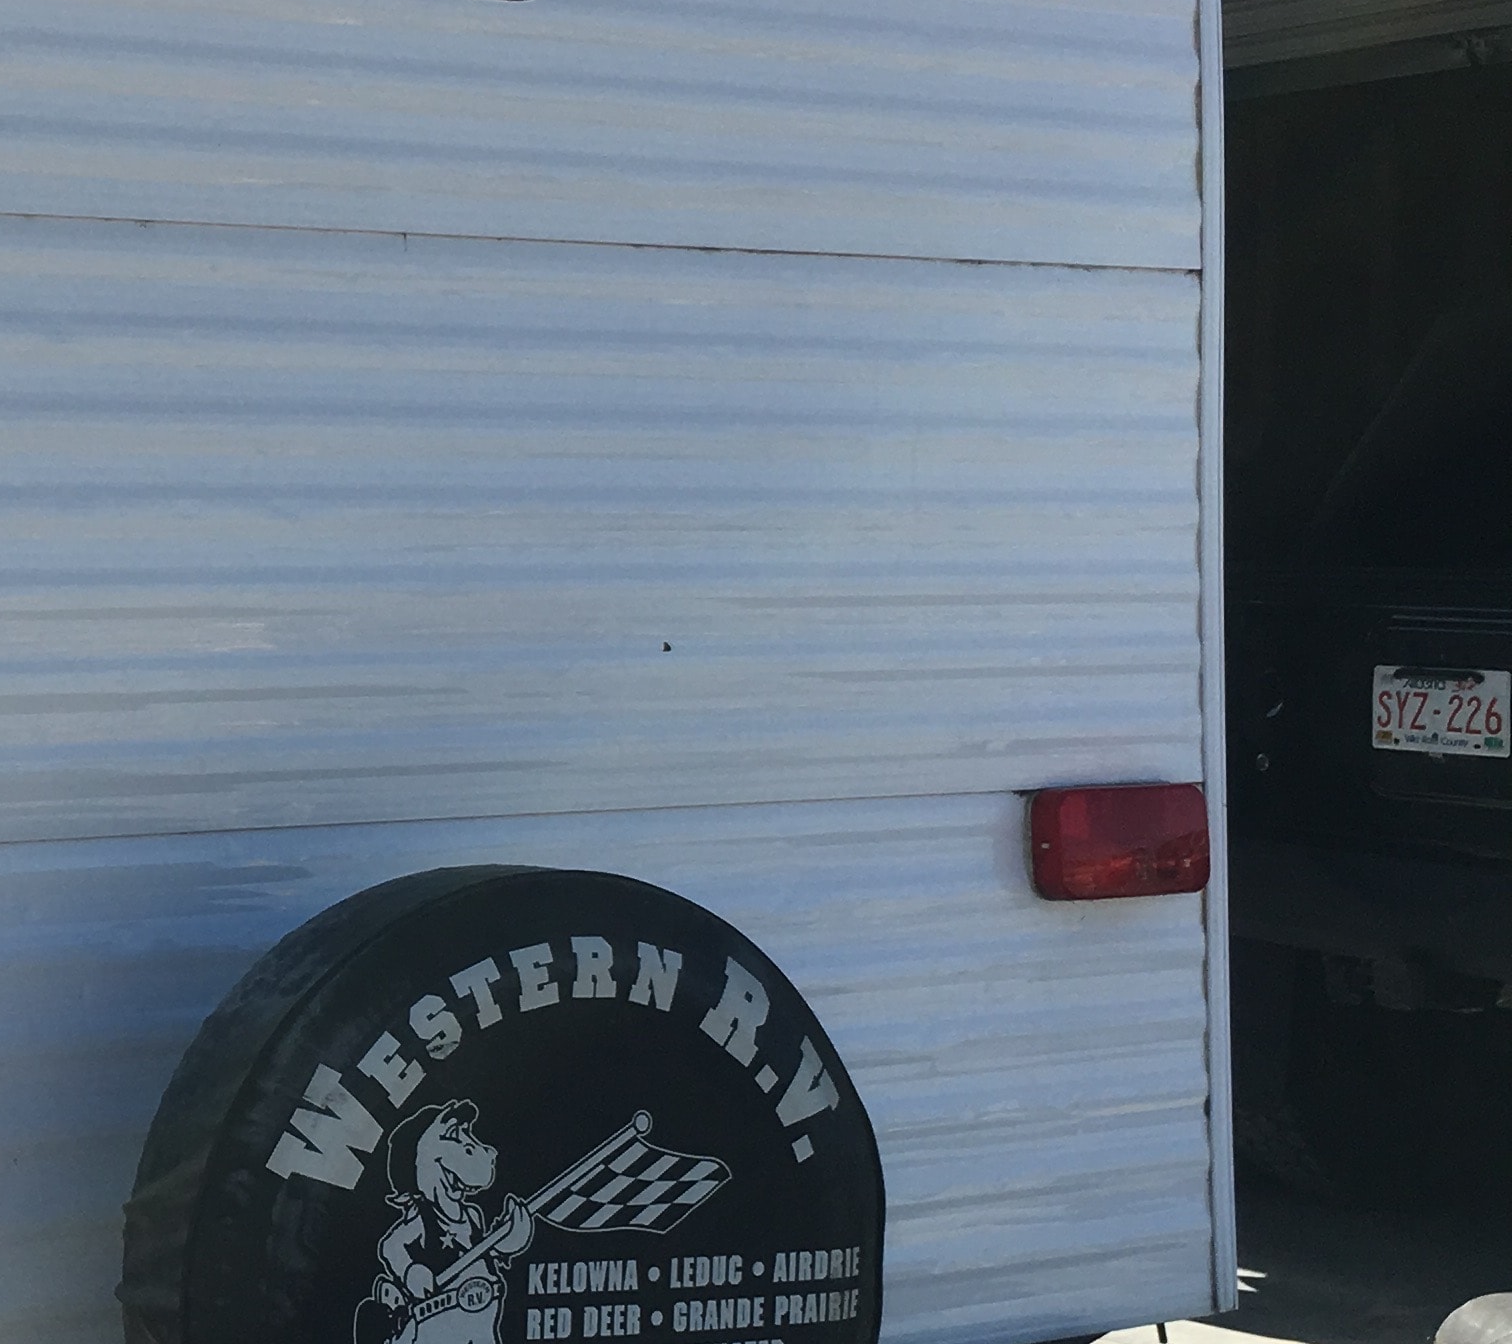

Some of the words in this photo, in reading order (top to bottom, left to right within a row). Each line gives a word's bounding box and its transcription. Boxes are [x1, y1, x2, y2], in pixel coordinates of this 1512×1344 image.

[1377, 690, 1503, 735] SYZ-226
[265, 935, 683, 1190] WESTERN
[699, 956, 840, 1163] R.V.
[528, 1260, 639, 1295] KELOWNA
[669, 1254, 743, 1289] LEDUC
[772, 1247, 861, 1283] AIRDRIE
[526, 1307, 572, 1340] RED
[583, 1304, 641, 1338] DEER
[673, 1297, 765, 1333] GRANDE
[774, 1288, 860, 1326] PRAIRIE
